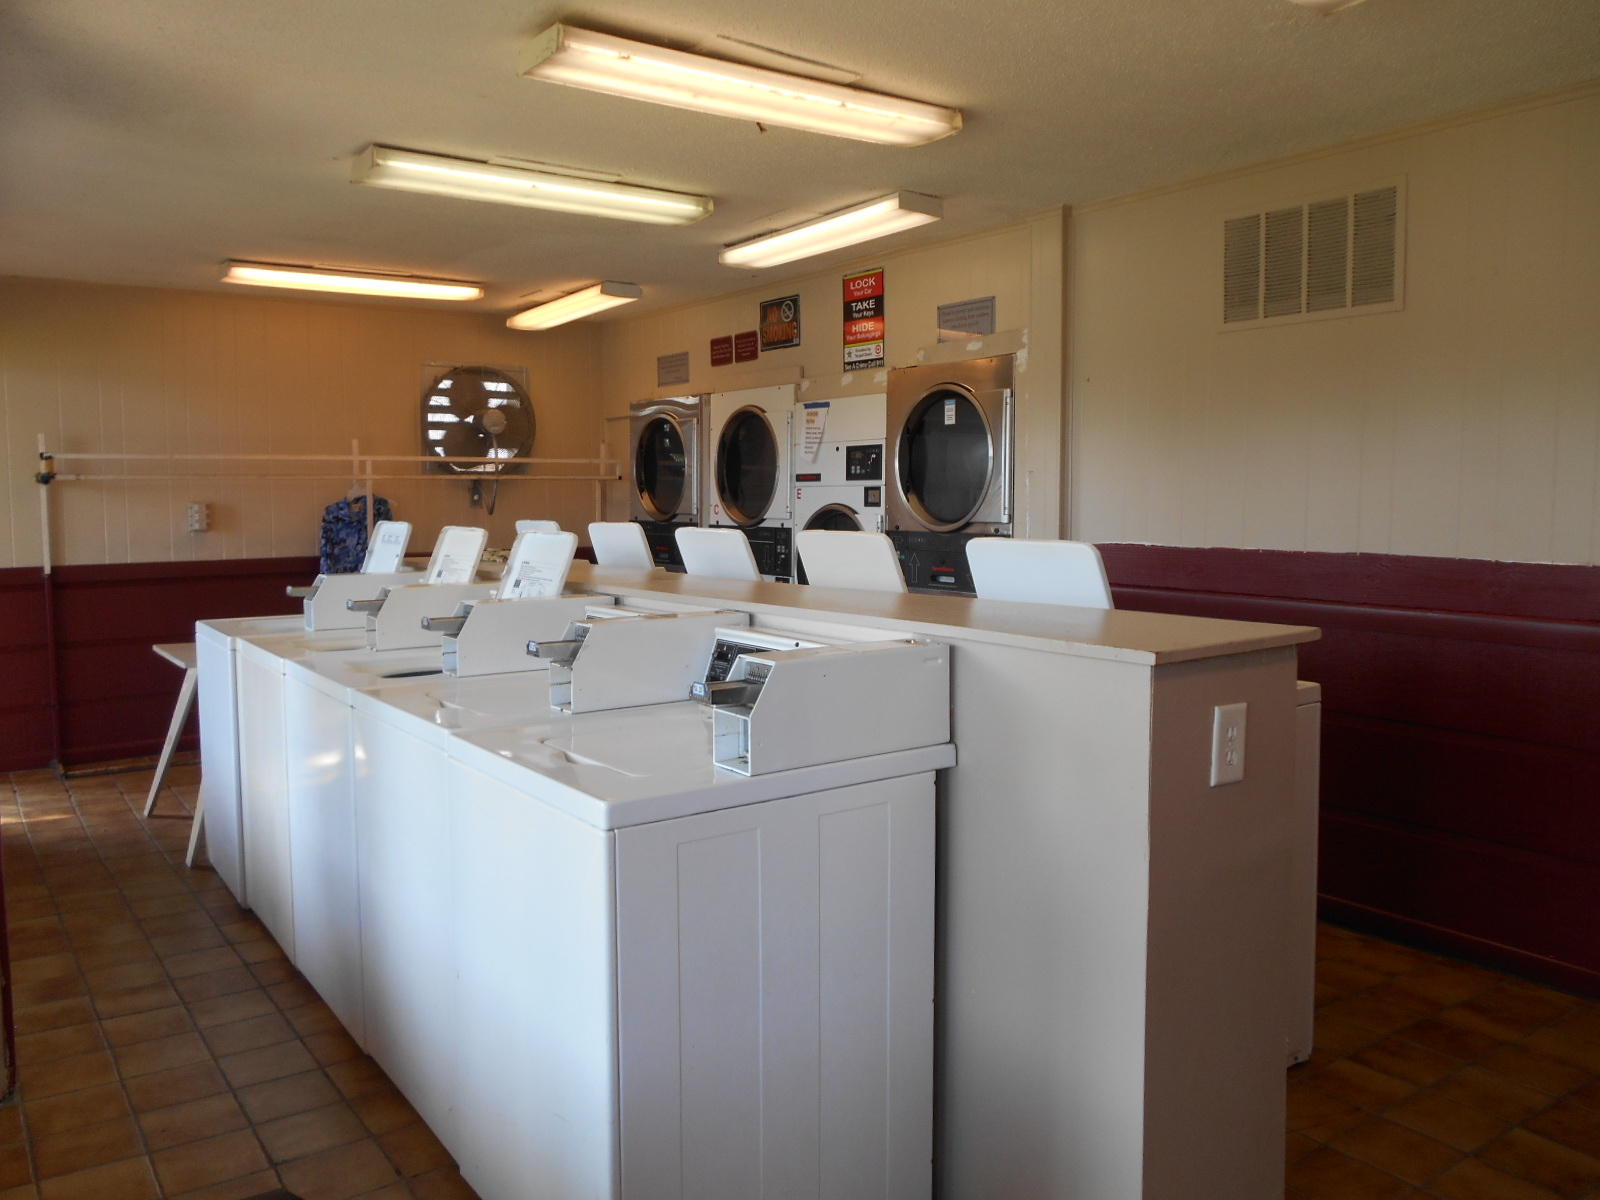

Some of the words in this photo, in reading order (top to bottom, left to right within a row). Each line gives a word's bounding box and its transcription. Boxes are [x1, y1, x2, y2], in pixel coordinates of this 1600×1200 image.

[850, 278, 876, 290] LOCK
[864, 288, 873, 296] Car
[851, 299, 875, 311] TAKE
[852, 311, 863, 320] Your
[863, 310, 874, 319] Keys
[852, 322, 875, 333] HIDE
[796, 488, 802, 499] E
[713, 504, 719, 515] C
